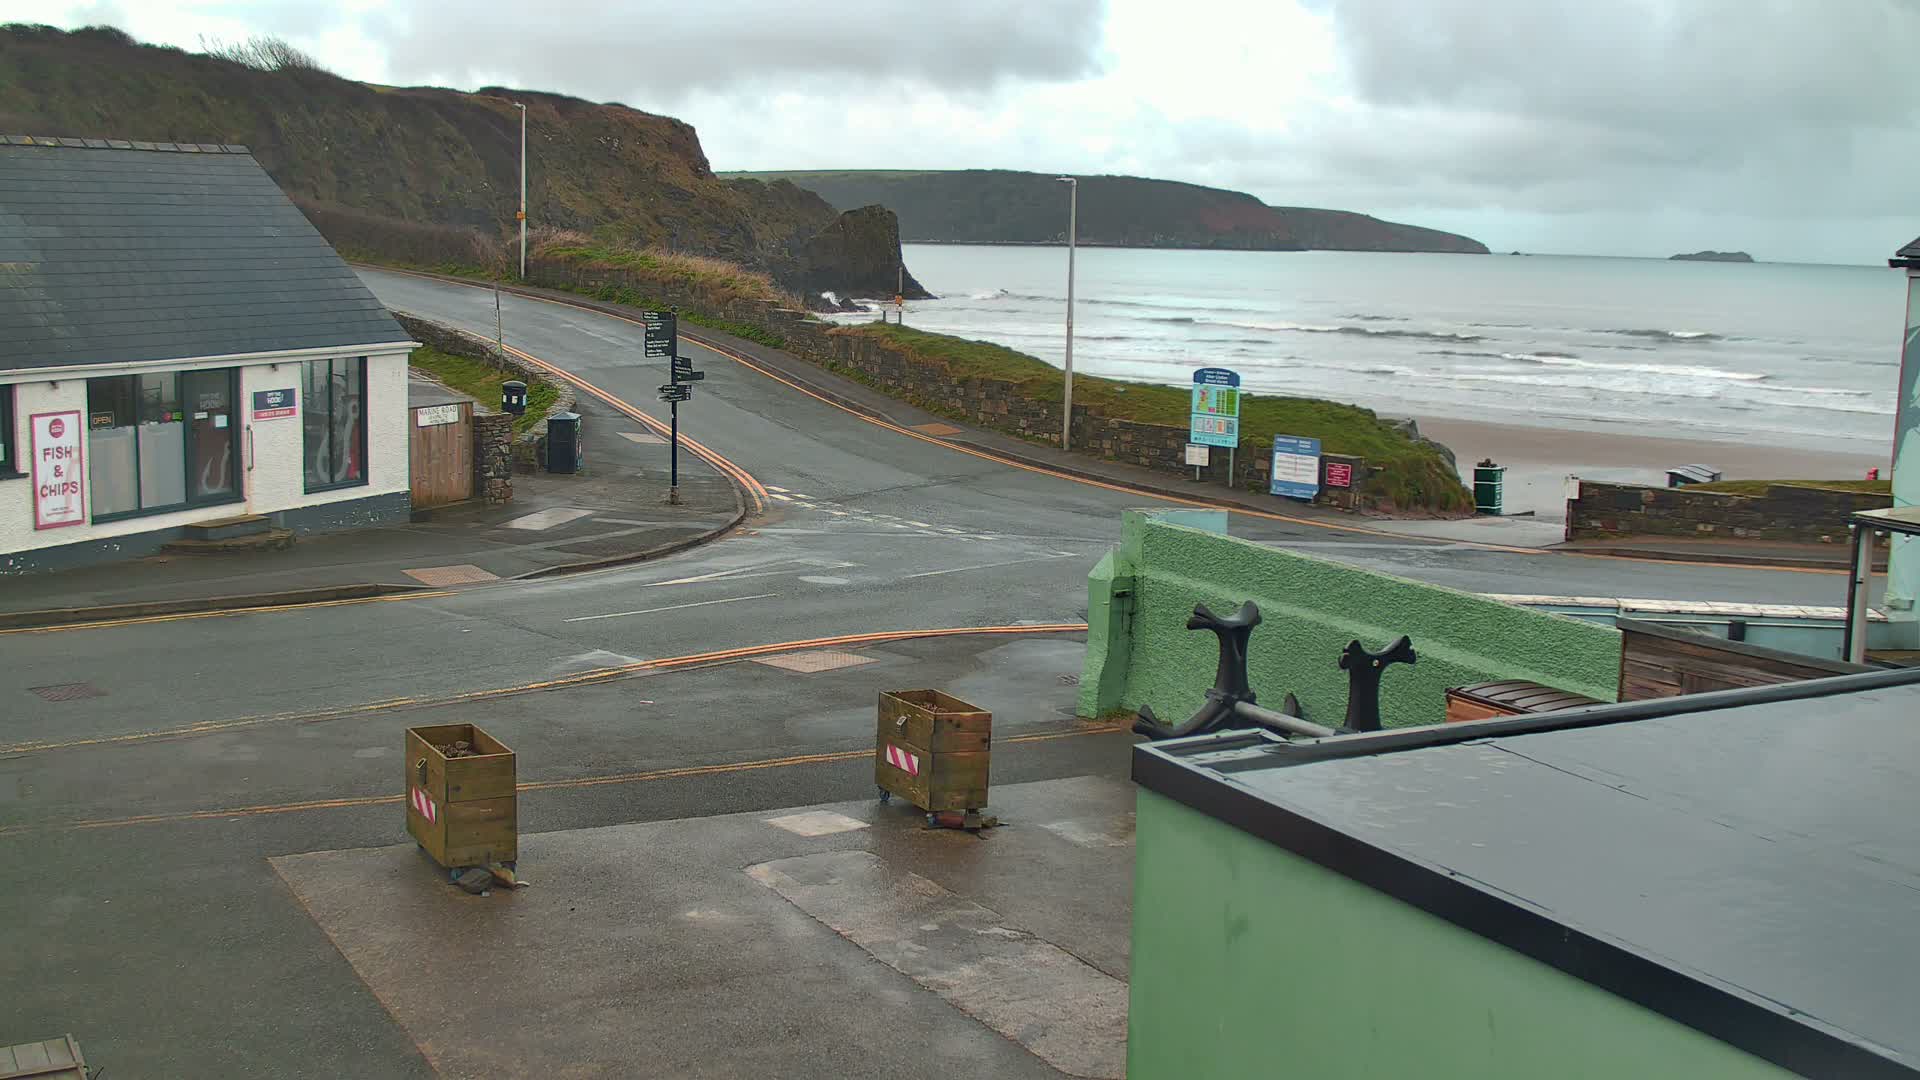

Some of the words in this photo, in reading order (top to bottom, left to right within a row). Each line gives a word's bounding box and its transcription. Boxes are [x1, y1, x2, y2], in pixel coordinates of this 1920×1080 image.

[92, 416, 112, 425] OPEN
[43, 445, 73, 462] FISH
[53, 464, 64, 478] &
[40, 480, 79, 498] CHIPS
